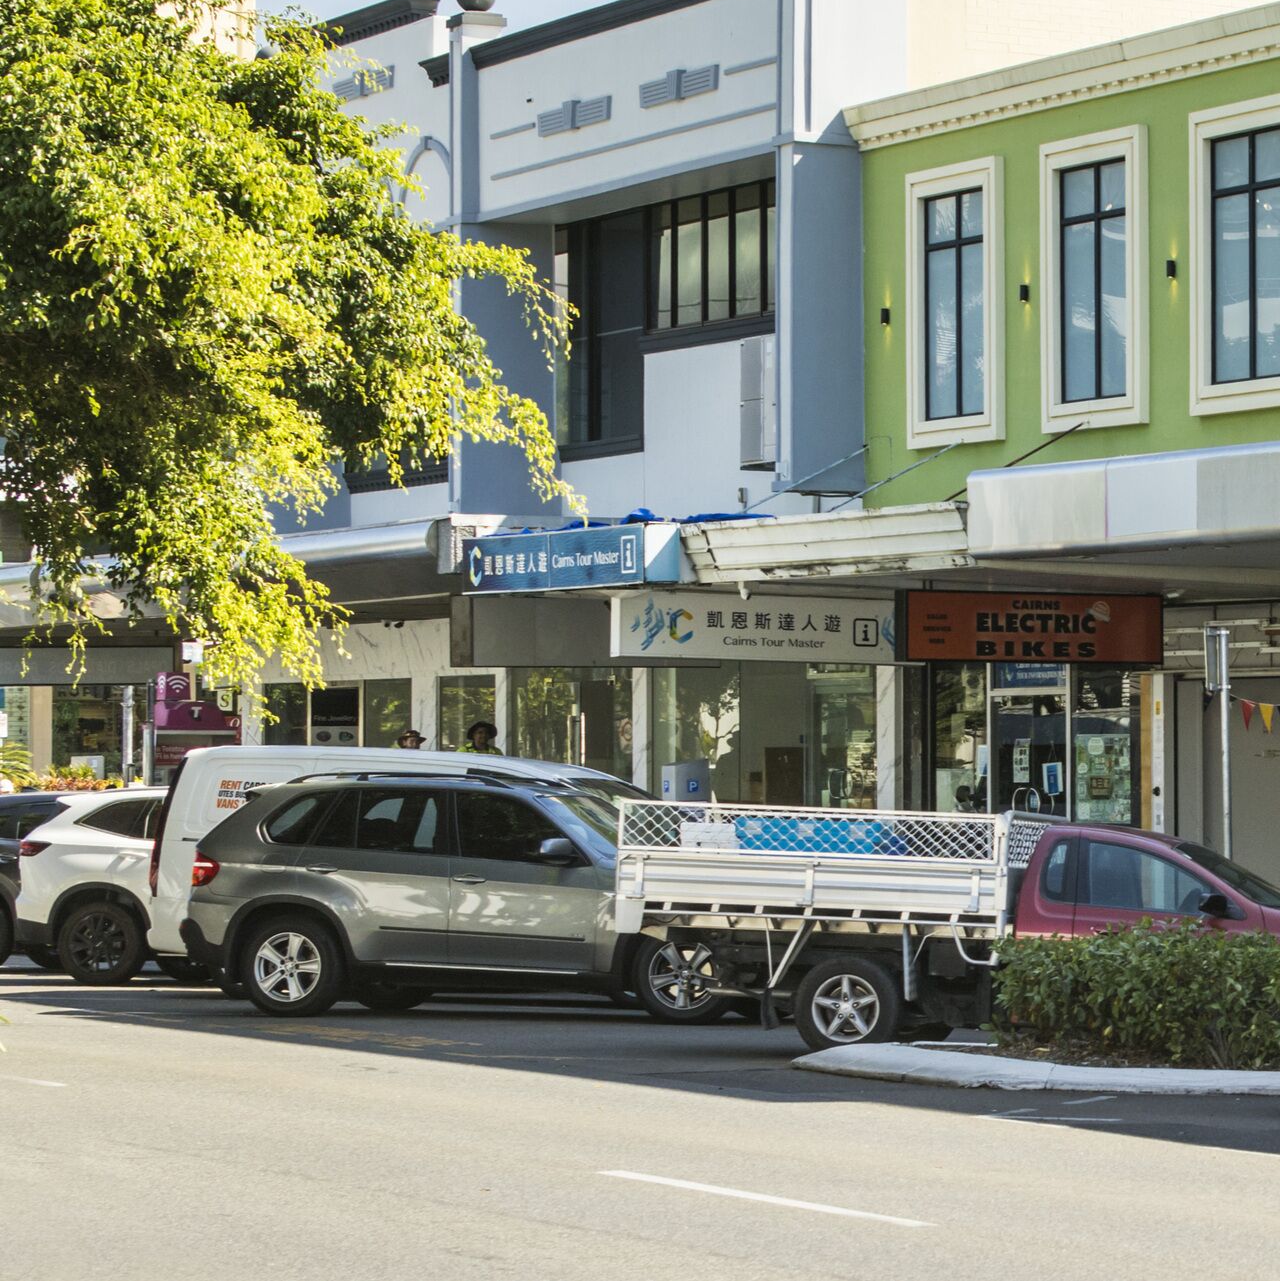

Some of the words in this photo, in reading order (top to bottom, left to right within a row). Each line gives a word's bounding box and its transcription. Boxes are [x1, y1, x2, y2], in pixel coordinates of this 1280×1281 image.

[552, 553, 574, 569] Cairns
[576, 551, 592, 566] Tour
[594, 550, 619, 566] Master
[1012, 600, 1060, 611] CAIRNS
[706, 610, 841, 634] 凱恩斯達人遊
[976, 612, 1097, 634] ELECTRIC
[723, 636, 757, 648] Cairns
[760, 637, 785, 648] Tour
[788, 638, 826, 649] Master
[976, 641, 1096, 658] BIKES
[220, 780, 243, 790] RENT
[216, 799, 239, 809] VANS
